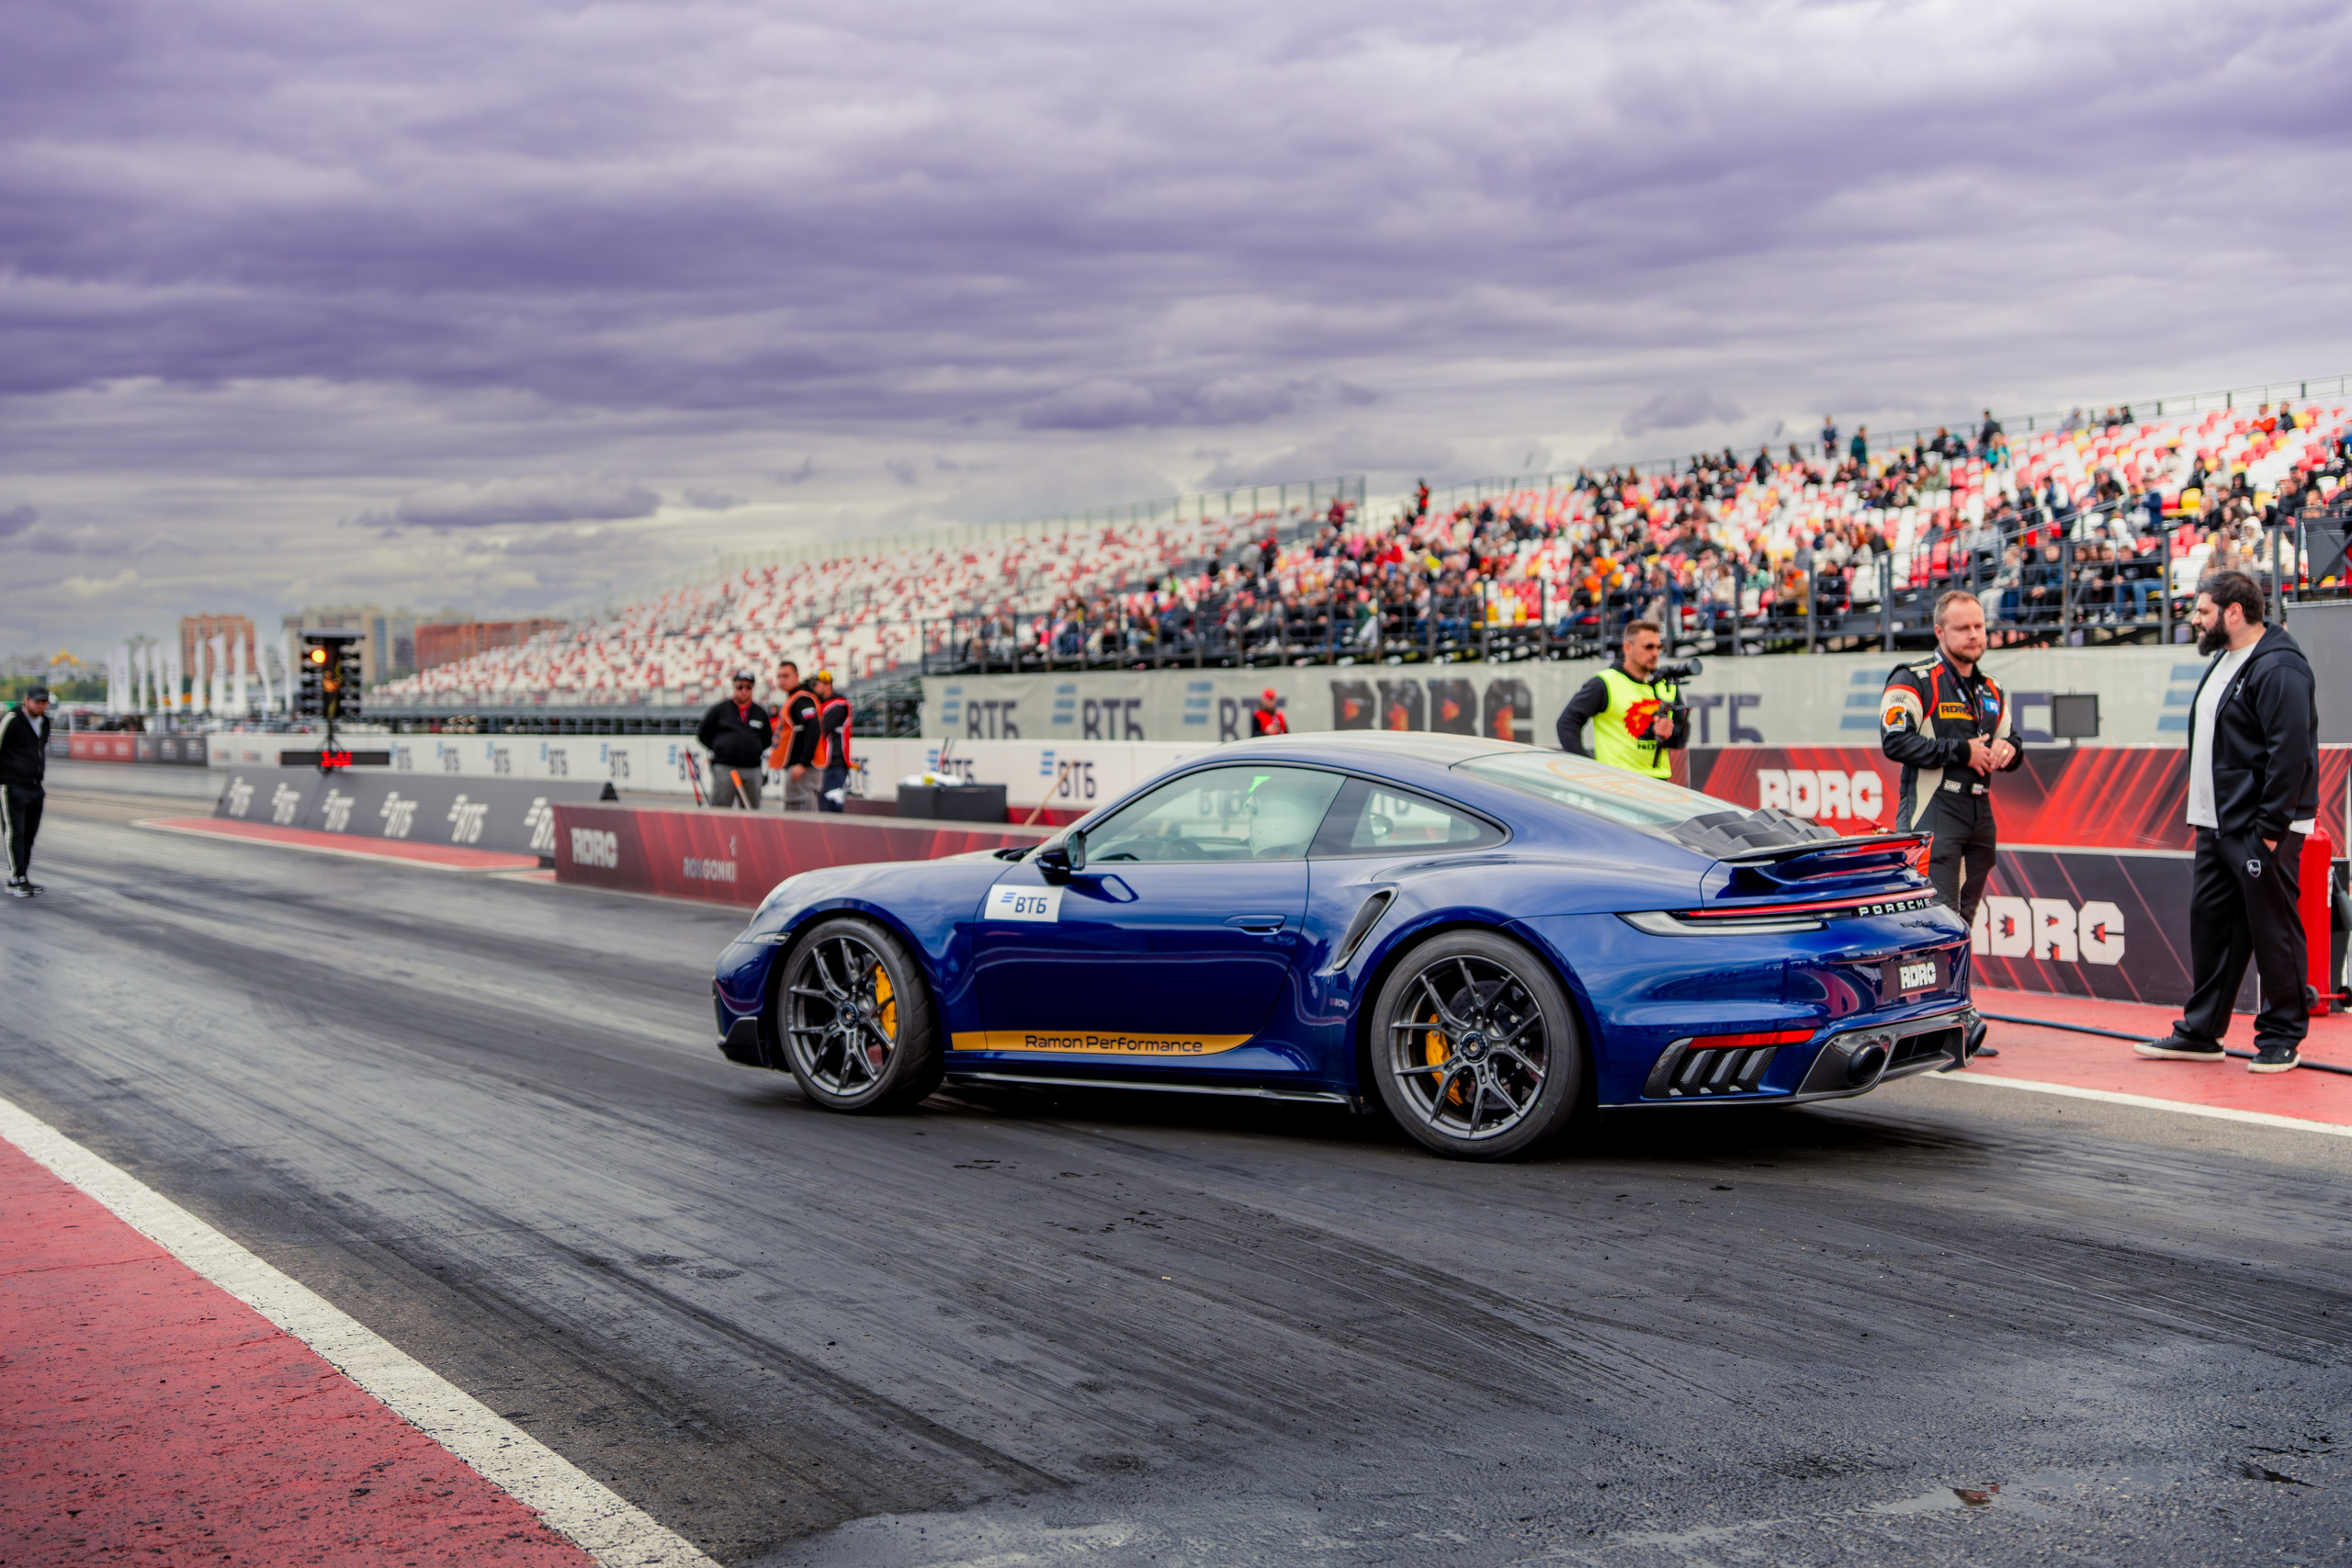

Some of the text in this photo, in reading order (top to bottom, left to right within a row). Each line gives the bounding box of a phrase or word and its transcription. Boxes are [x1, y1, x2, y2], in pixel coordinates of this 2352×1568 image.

[1685, 693, 1765, 743] ТБ
[1757, 769, 1883, 819] RDRC
[570, 827, 619, 869] RDRC
[1014, 896, 1047, 915] ВТБ
[1858, 897, 1931, 917] PORSCHE
[1899, 961, 1937, 990] RDRC
[1024, 1034, 1203, 1053] Ramon Performance
